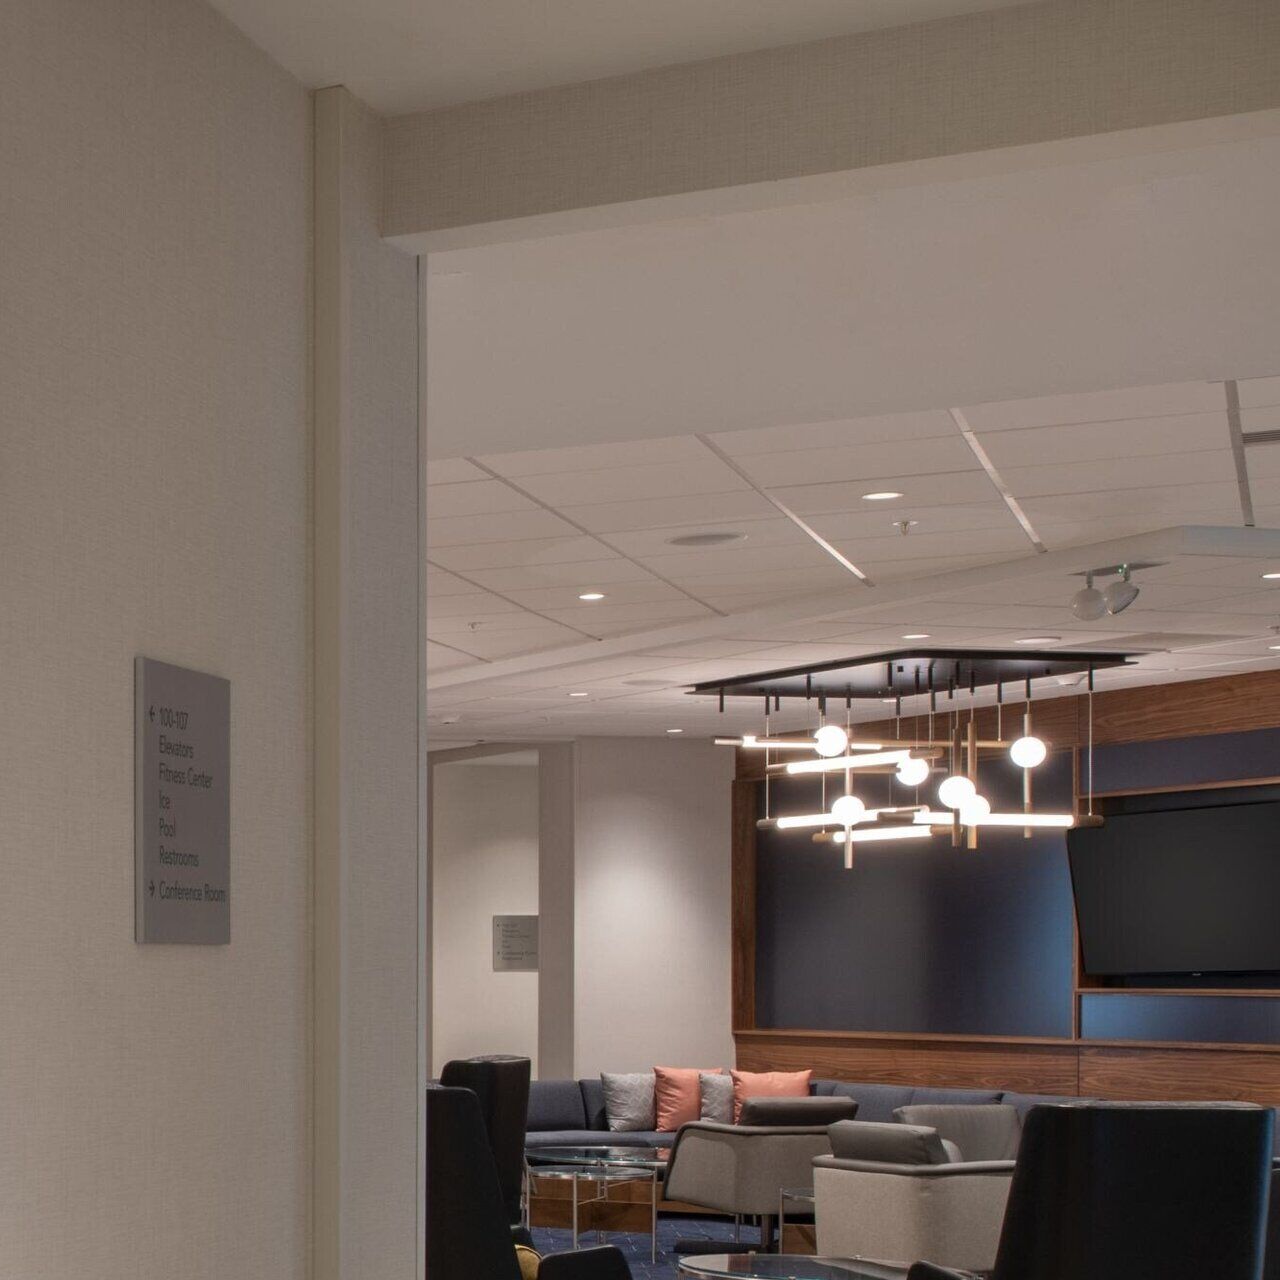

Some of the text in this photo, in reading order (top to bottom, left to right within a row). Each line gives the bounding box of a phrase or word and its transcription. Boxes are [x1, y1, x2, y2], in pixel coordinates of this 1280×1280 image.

[159, 735, 193, 758] Elevators
[159, 763, 212, 788] Fitness Center
[159, 791, 170, 809] Ice
[159, 817, 175, 837] Pool
[159, 845, 199, 866] Restrooms
[159, 880, 225, 902] Conference Room
